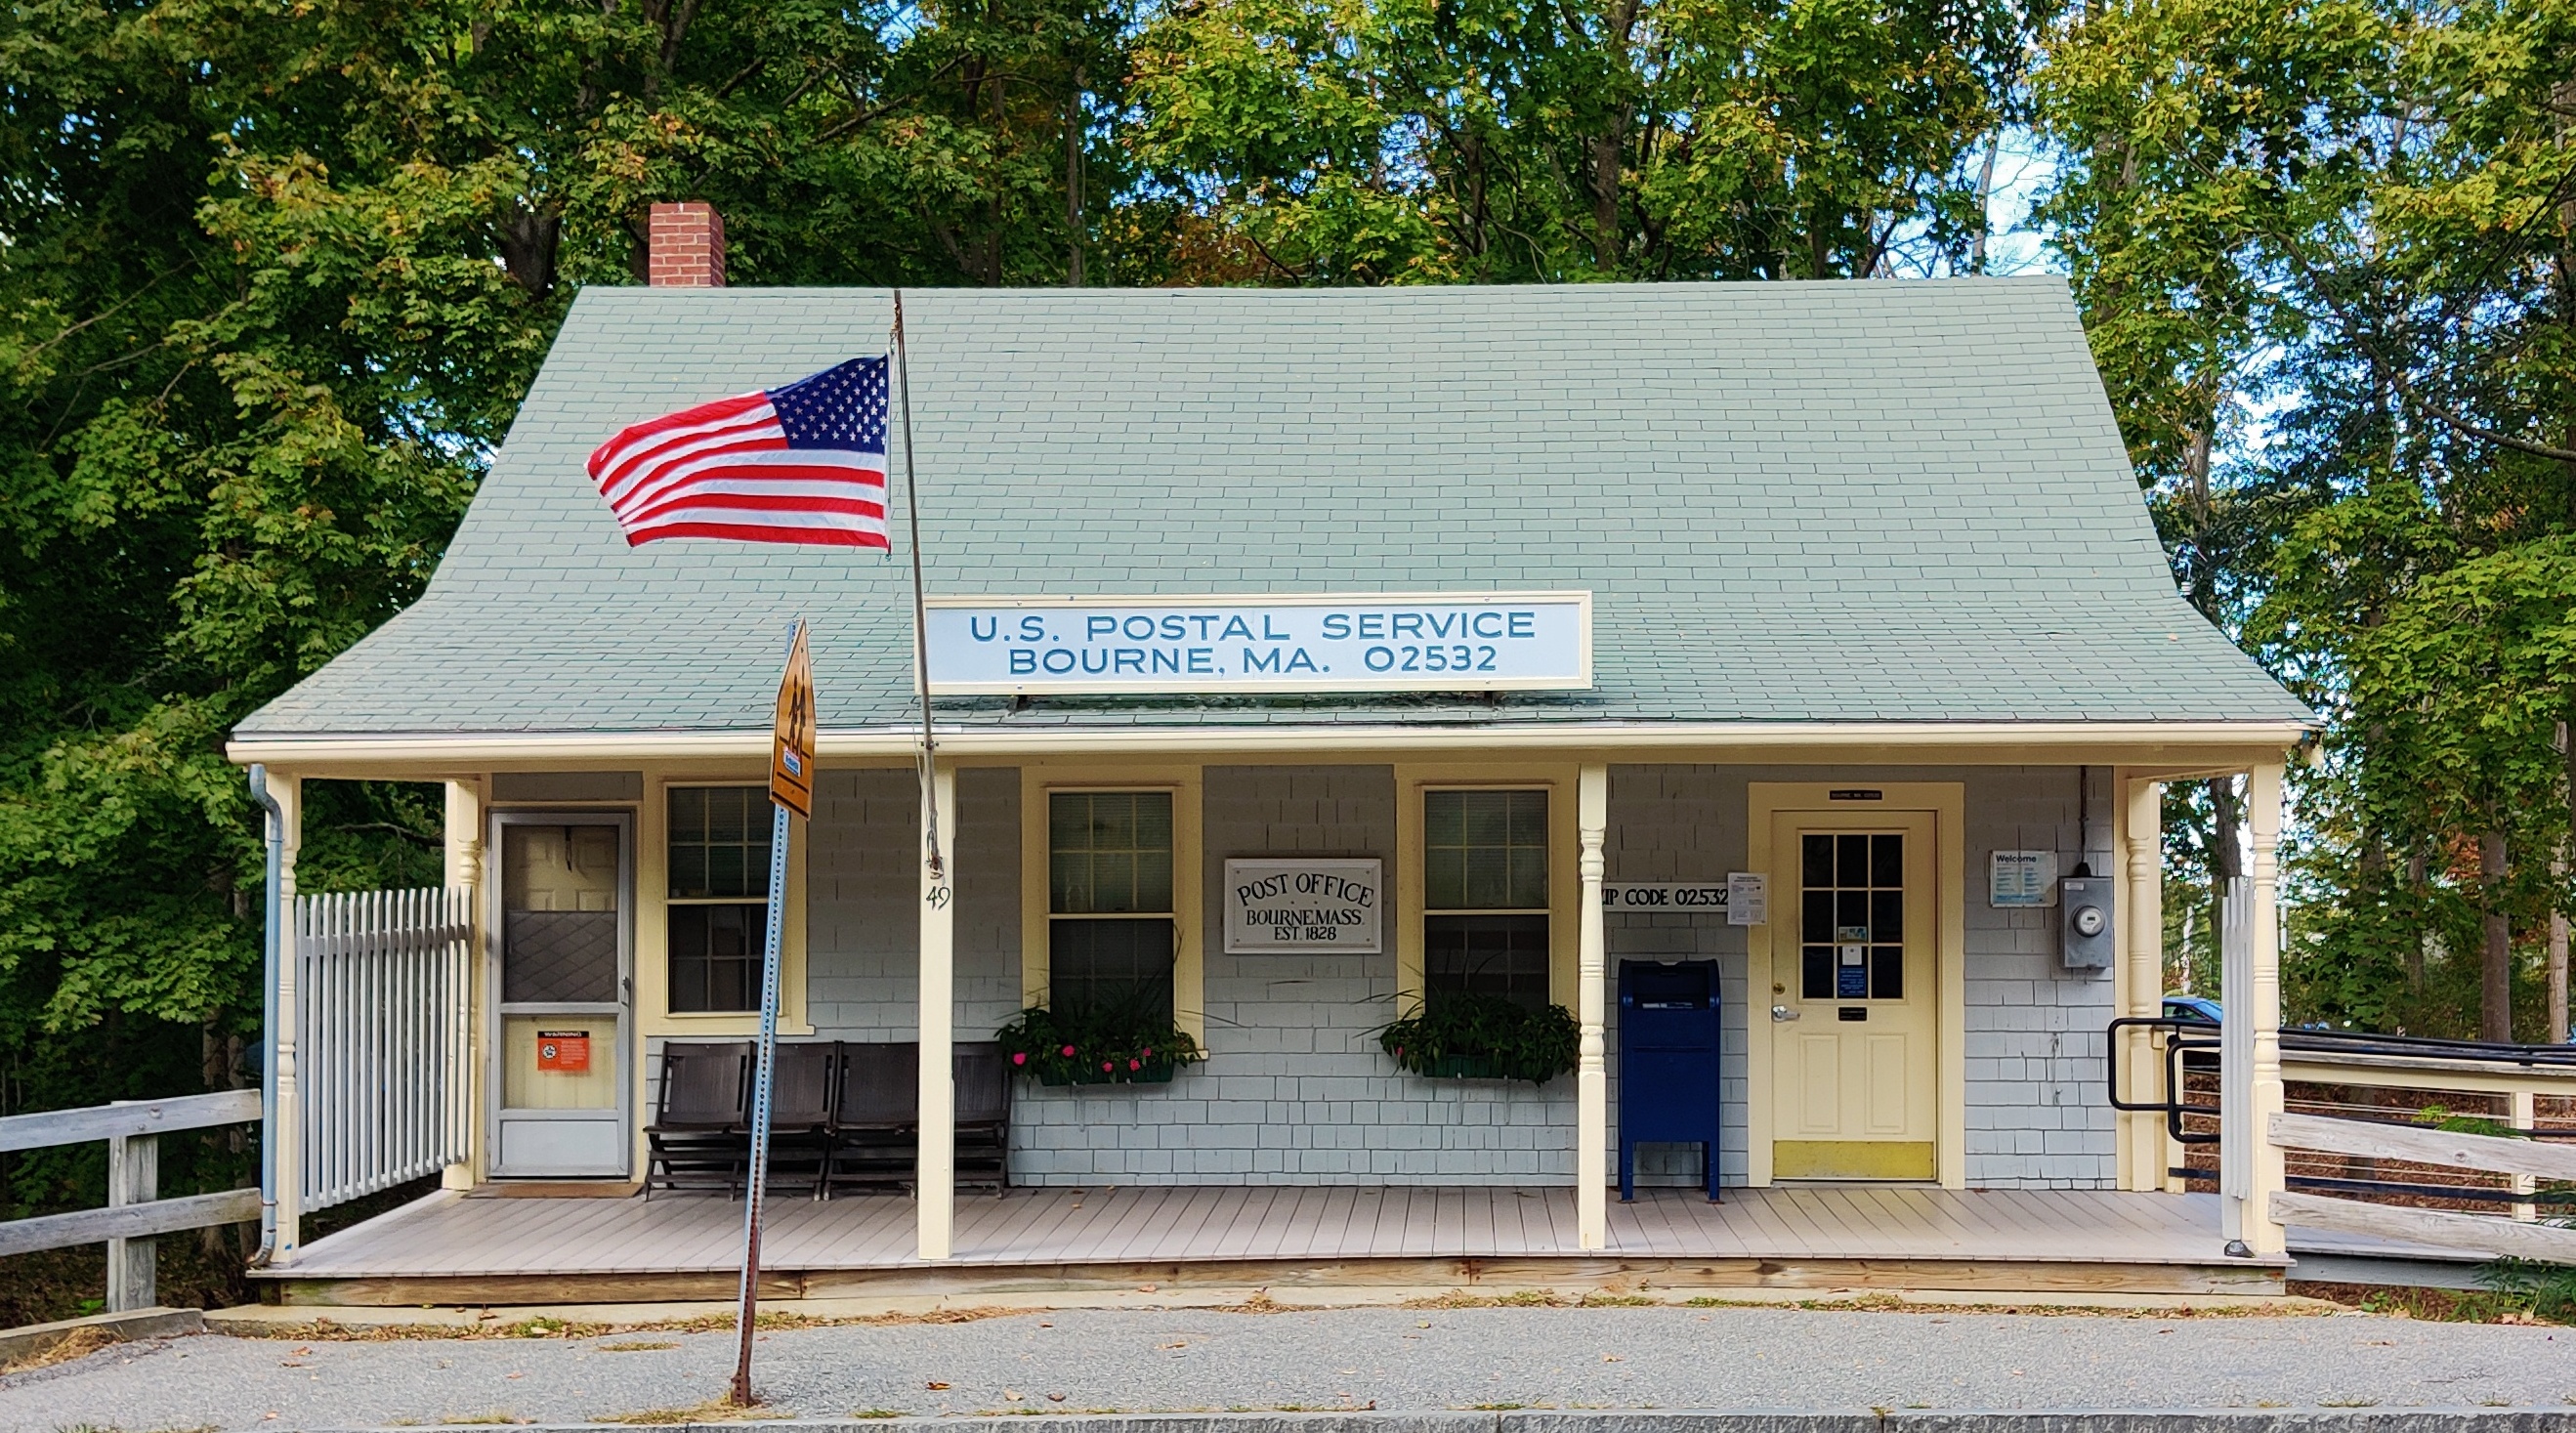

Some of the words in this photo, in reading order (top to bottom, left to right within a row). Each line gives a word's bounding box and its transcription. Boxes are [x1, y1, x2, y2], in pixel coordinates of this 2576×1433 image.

[970, 614, 1061, 643] U.S.
[1086, 613, 1291, 642] POSTAL
[1321, 611, 1536, 640] SERVICE
[1008, 647, 1226, 676] BOURNE,
[1243, 646, 1330, 674] MA.
[1364, 644, 1498, 673] 02532
[1996, 855, 2037, 864] Welcome
[925, 885, 950, 910] 49
[1237, 873, 1288, 906] POST
[1295, 872, 1374, 908] OFFICE
[1625, 888, 1669, 906] CODE
[1674, 888, 1729, 906] 02532
[1305, 926, 1337, 941] 1828
